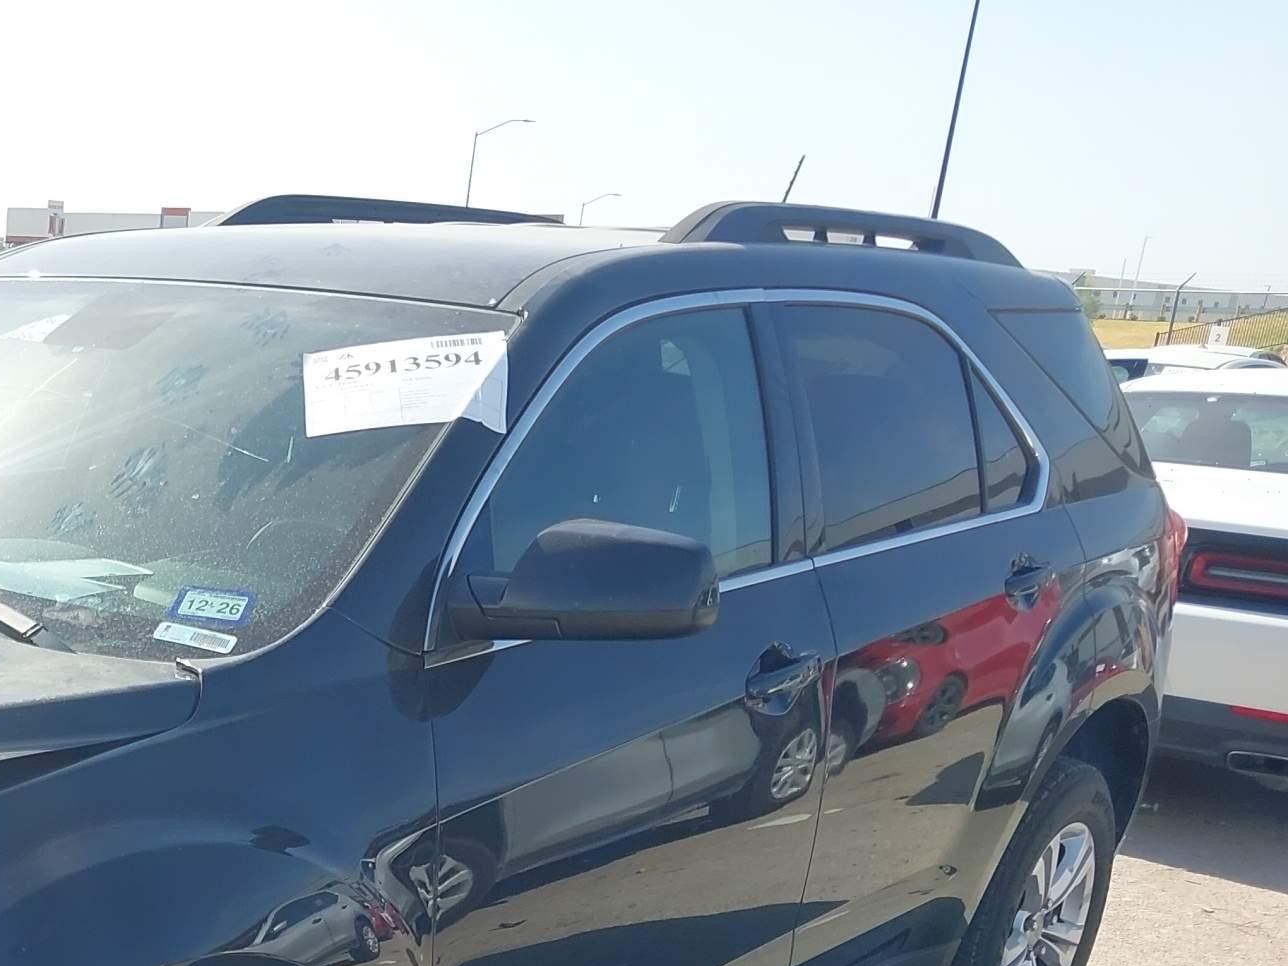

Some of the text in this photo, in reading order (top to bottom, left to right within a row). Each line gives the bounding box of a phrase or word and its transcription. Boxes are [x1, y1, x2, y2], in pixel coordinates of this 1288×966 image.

[324, 350, 483, 382] 45913594
[187, 599, 242, 616] 12 26
